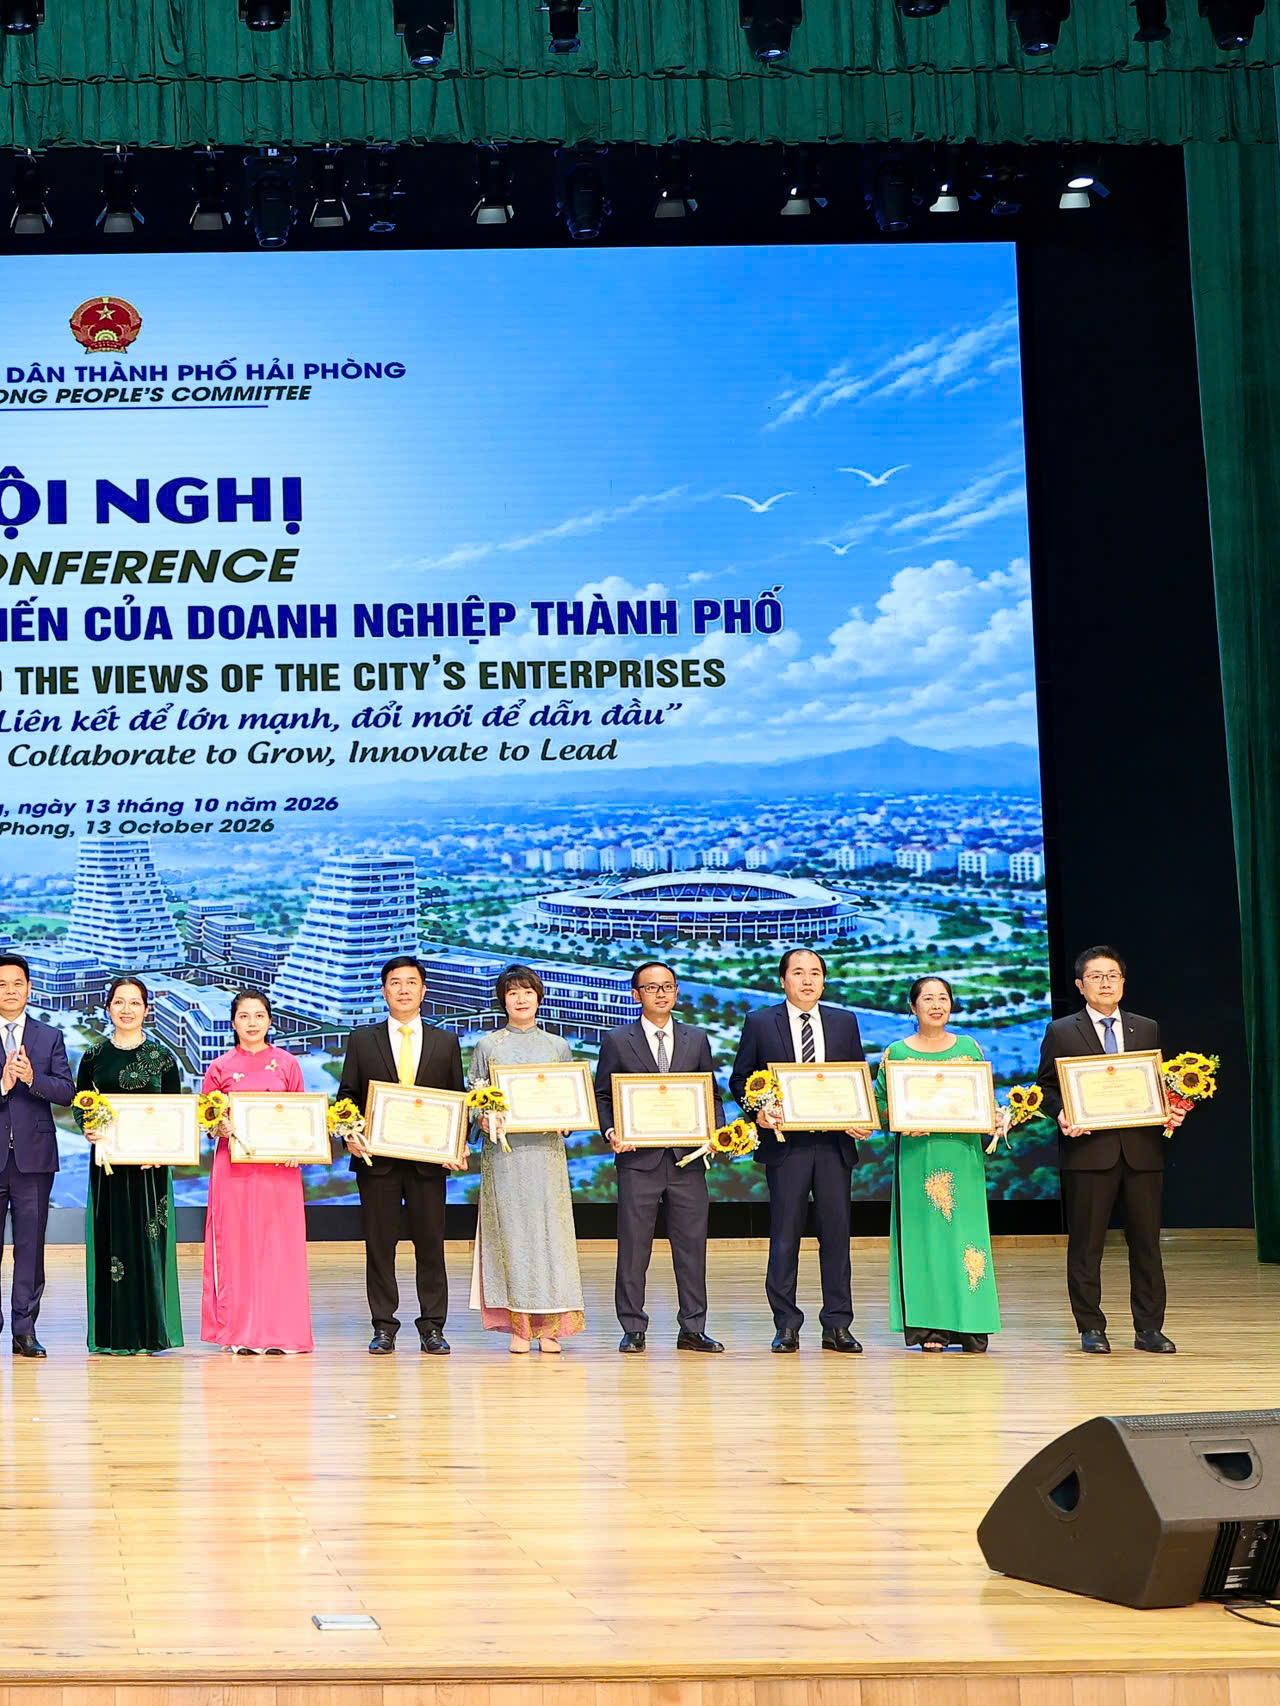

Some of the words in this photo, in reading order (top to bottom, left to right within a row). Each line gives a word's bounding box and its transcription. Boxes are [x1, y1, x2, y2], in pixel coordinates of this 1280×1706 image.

[6, 362, 65, 384] DÂN
[74, 360, 168, 383] THÀNH
[177, 356, 237, 382] PHỐ
[246, 357, 294, 381] HẢI
[303, 357, 407, 380] PHÒNG
[171, 385, 313, 402] COMMITTEE
[95, 476, 303, 536] NGHỊ
[84, 594, 173, 642] CỦA
[187, 603, 337, 641] DOANH
[353, 594, 516, 645] NGHIỆP
[530, 593, 678, 636] THÀNH
[693, 586, 782, 634] PHỐ
[14, 666, 80, 695] THE
[91, 664, 209, 694] VIEWS
[221, 663, 264, 693] OF
[274, 663, 341, 692] THE
[479, 658, 726, 690] ENTERPRISES
[70, 704, 121, 732] kết
[128, 702, 175, 731] để
[176, 707, 229, 731] lớn
[237, 707, 340, 735] mạnh,
[351, 700, 403, 729] đổi
[411, 704, 474, 728] mới
[481, 698, 527, 727] để
[529, 699, 593, 727] dẫn
[7, 743, 196, 767] Collaborate
[206, 744, 237, 765] to
[247, 740, 336, 767] Grow,
[348, 740, 489, 763] Innovate
[499, 741, 530, 762] to
[540, 738, 618, 761] Lead
[17, 798, 77, 819] ngày
[86, 799, 111, 814] 13
[117, 797, 185, 817] tháng
[194, 798, 220, 813] 10
[225, 796, 277, 812] năm
[283, 796, 339, 812] 2026
[87, 820, 112, 835] 13
[118, 819, 214, 835] October
[218, 818, 275, 833] 2026
